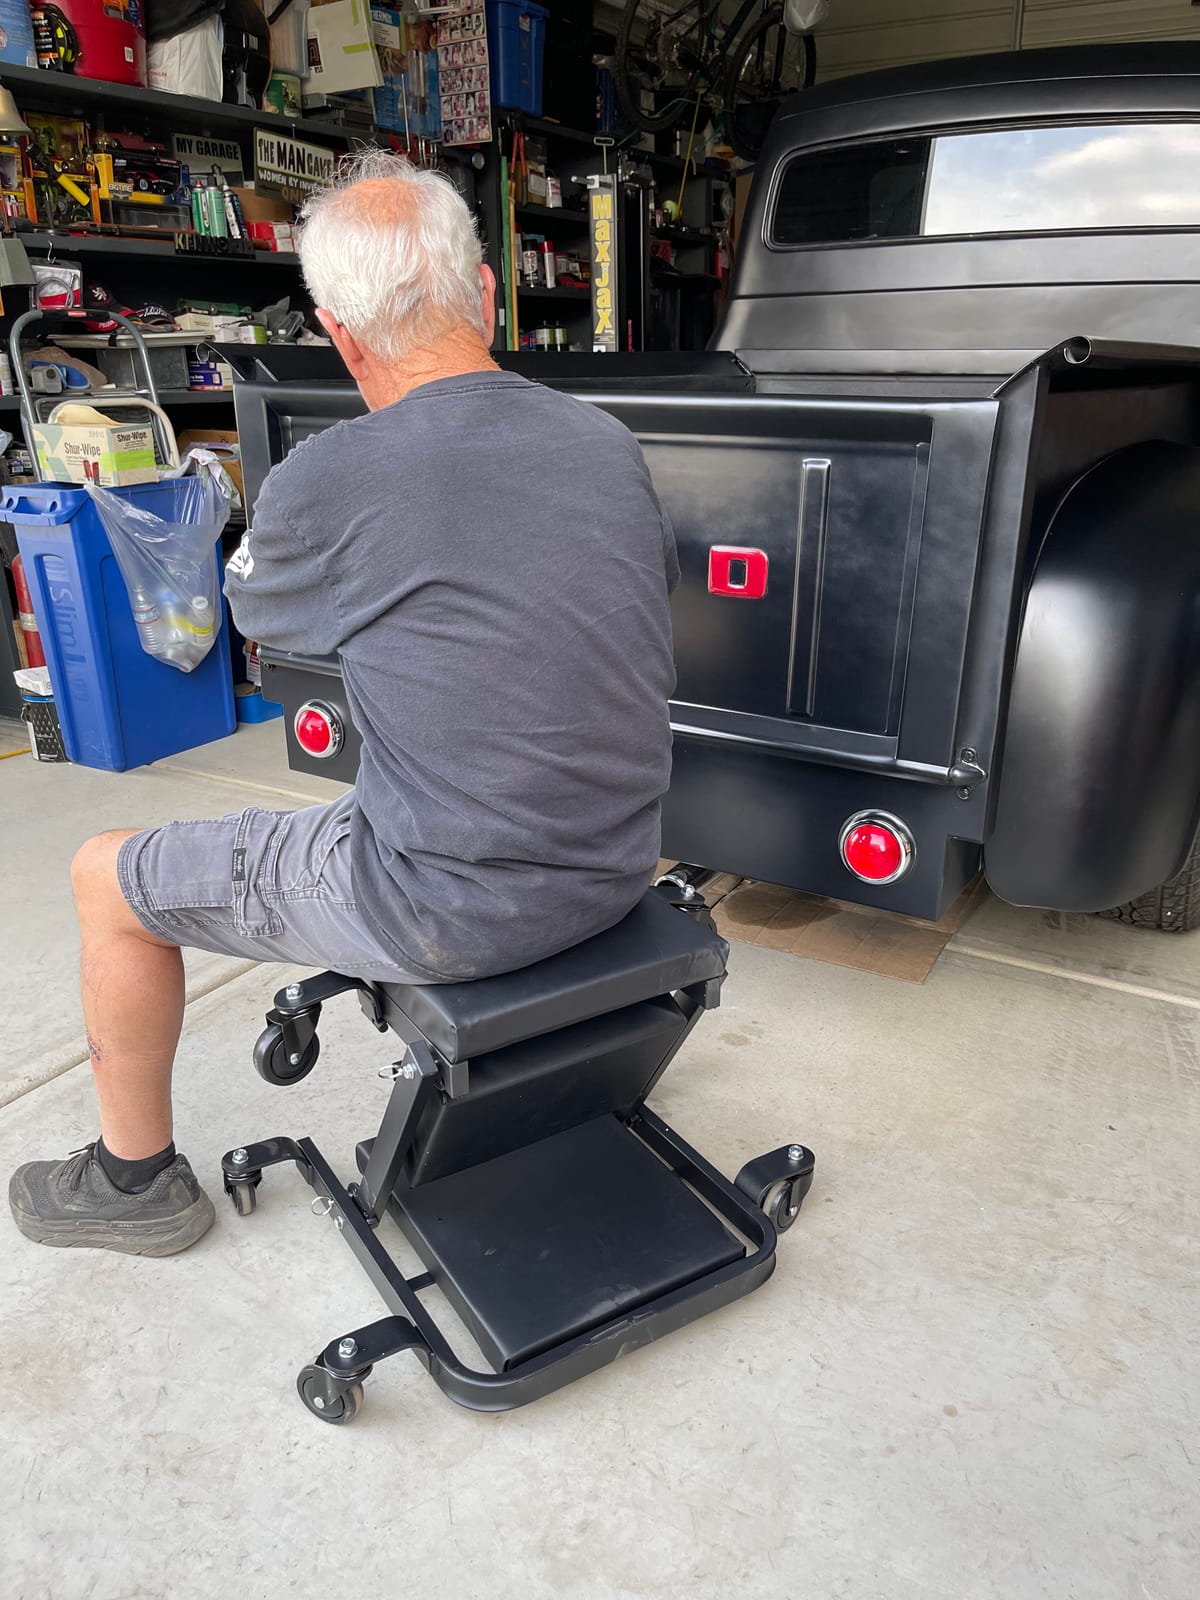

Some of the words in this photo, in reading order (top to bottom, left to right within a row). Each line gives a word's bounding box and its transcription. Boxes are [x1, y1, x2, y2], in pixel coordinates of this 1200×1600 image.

[176, 137, 193, 154] MY
[196, 141, 239, 160] GARAGE
[258, 138, 275, 163] THE
[276, 141, 306, 175] MAN
[258, 169, 287, 185] WOMEN
[117, 431, 148, 443] Shur-Wipe
[64, 441, 101, 456] Shur-Wipe
[708, 545, 768, 600] D
